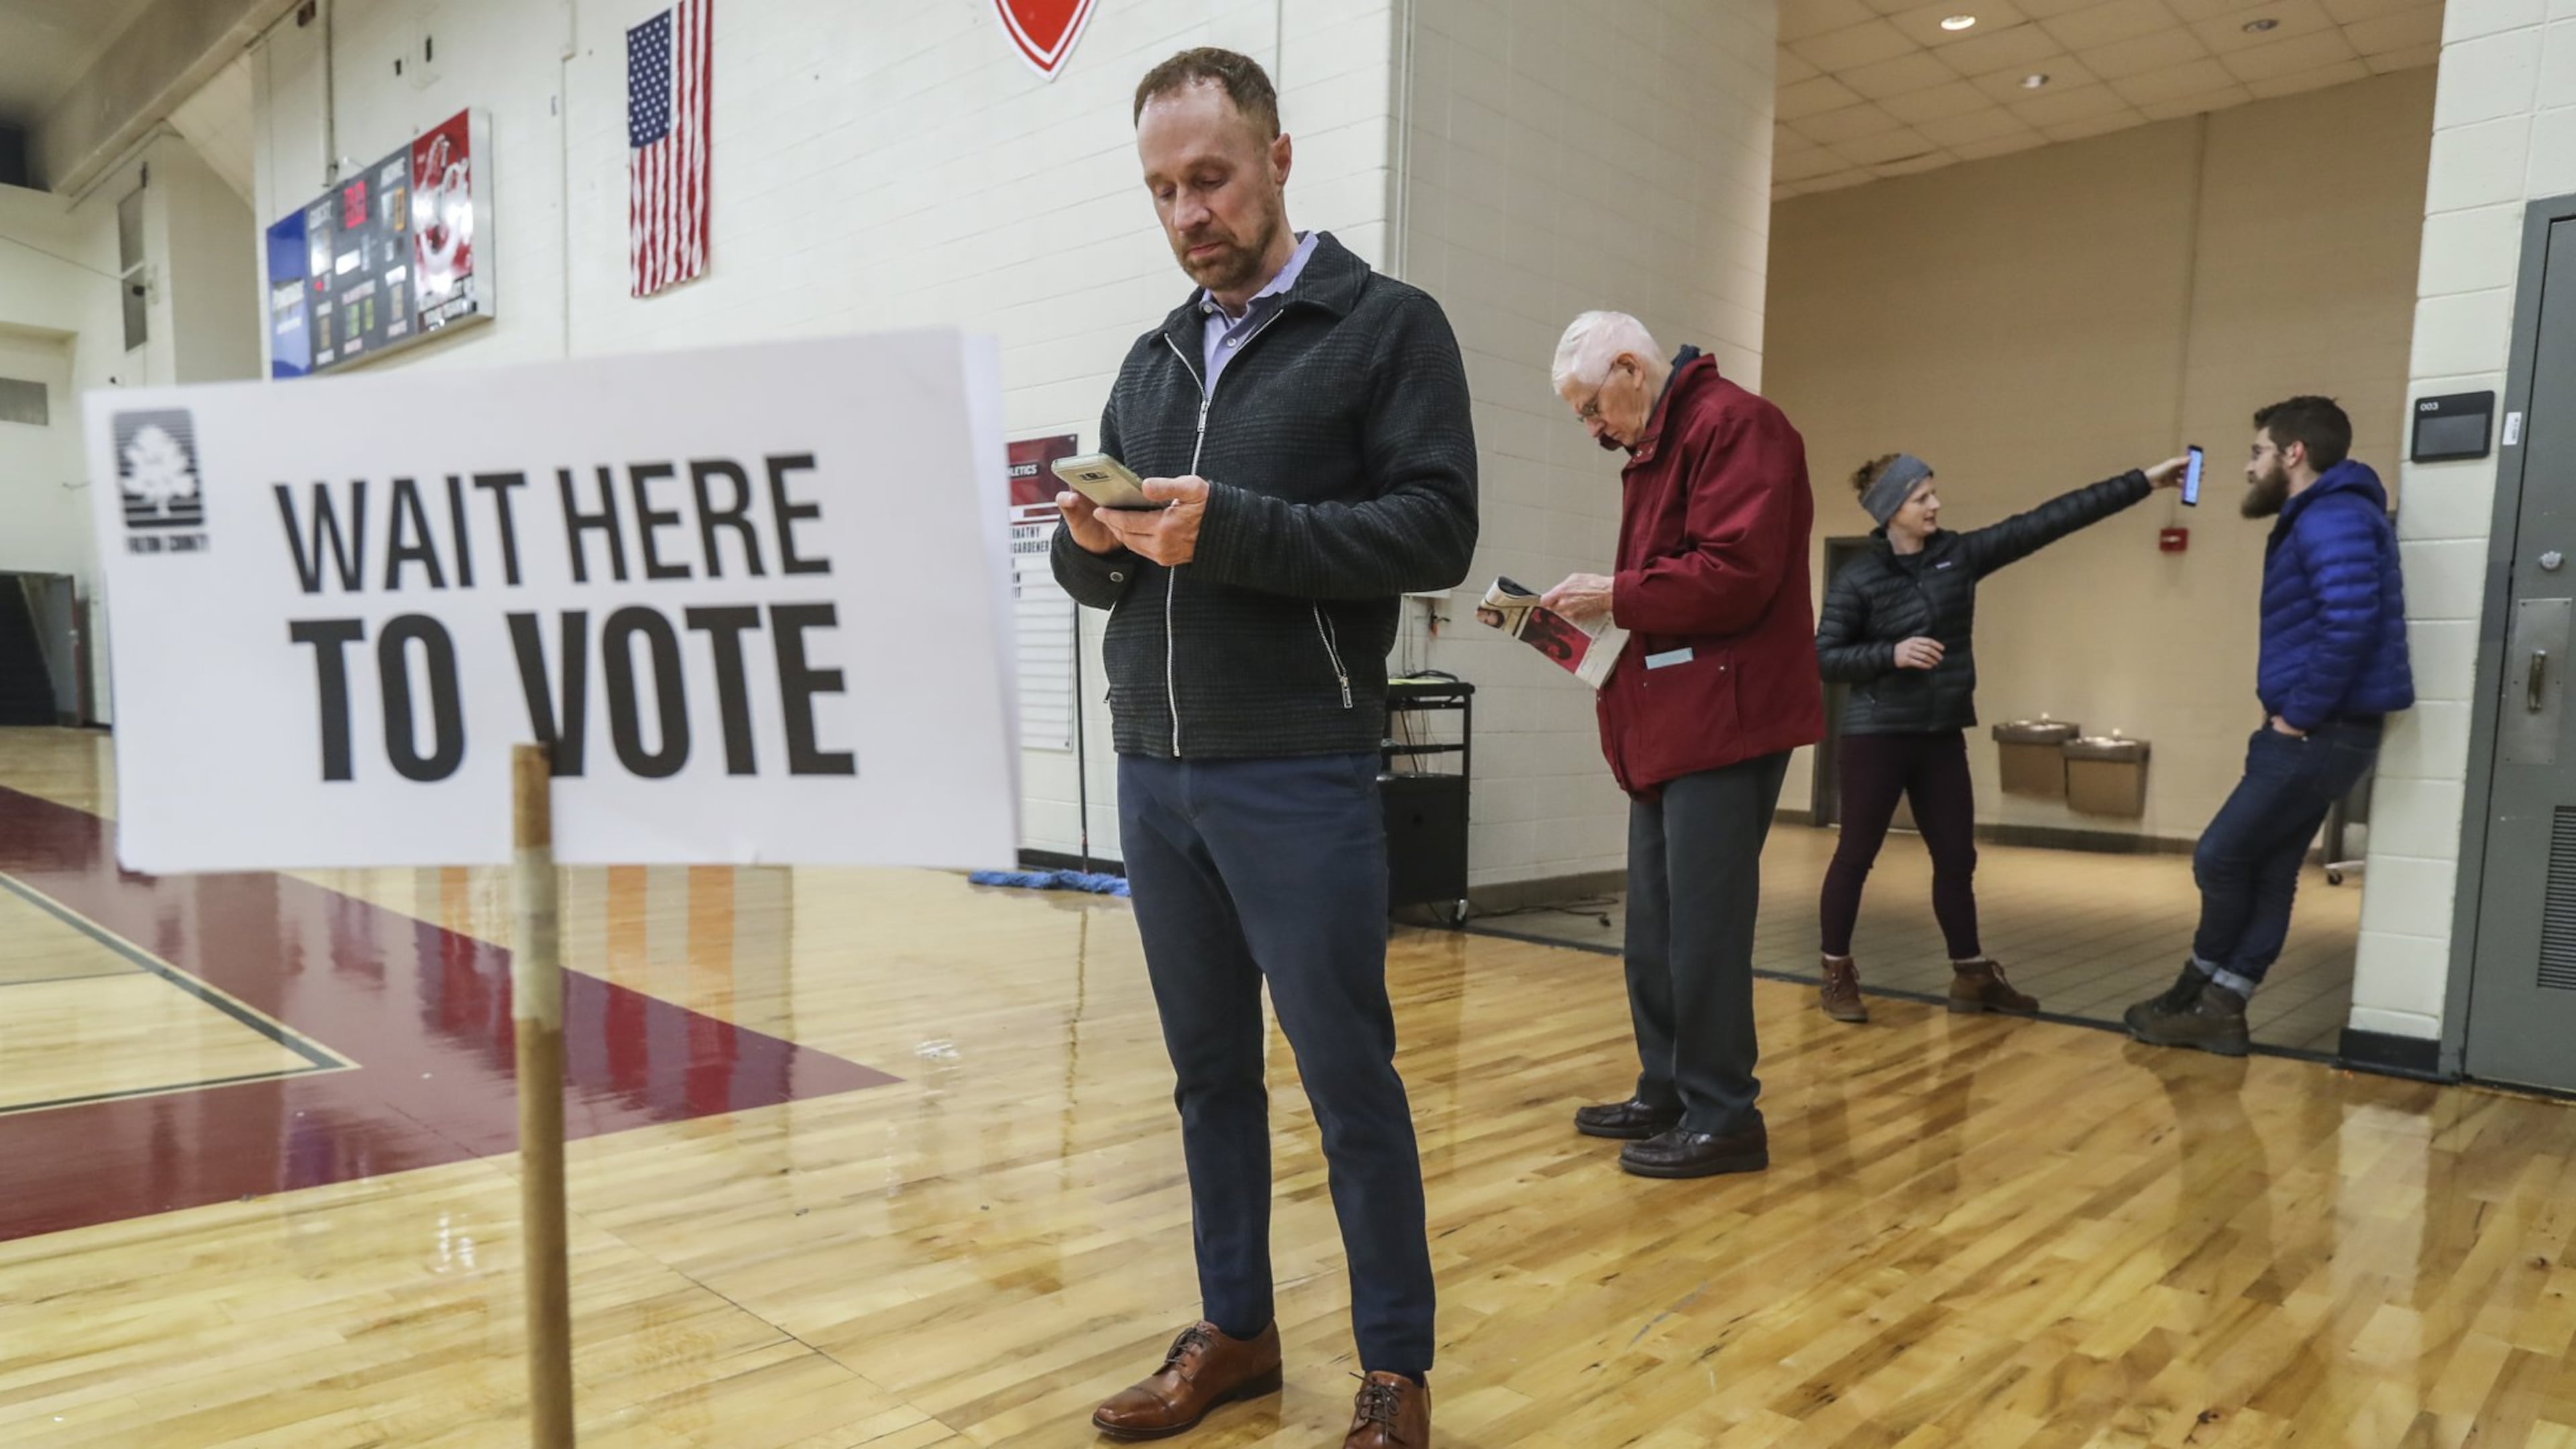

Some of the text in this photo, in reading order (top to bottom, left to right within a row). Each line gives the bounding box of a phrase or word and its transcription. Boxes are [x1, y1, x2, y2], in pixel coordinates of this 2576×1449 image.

[2419, 401, 2439, 411] 003
[1008, 464, 1038, 477] LETICS
[274, 453, 831, 594] WAIT HERE
[1011, 540, 1049, 553] GARDENER
[289, 602, 856, 783] TO VOTE
